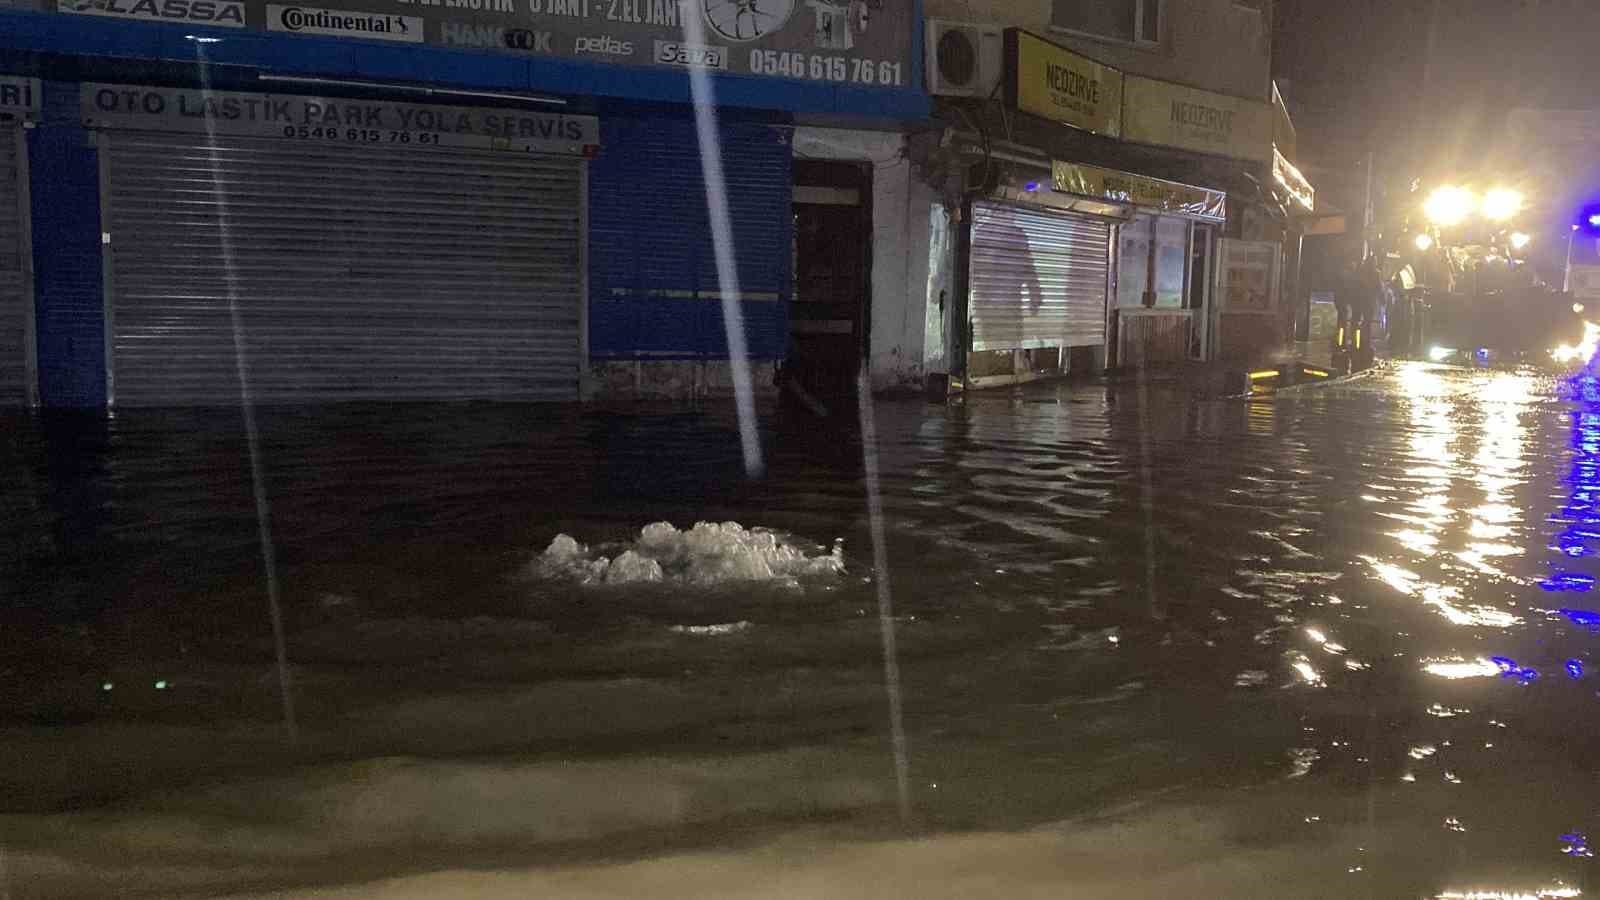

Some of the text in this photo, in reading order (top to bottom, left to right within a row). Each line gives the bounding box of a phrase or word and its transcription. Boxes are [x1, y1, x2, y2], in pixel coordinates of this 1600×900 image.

[281, 8, 391, 32] Continental
[750, 49, 901, 86] 0546 615 76 61
[96, 88, 584, 141] OTO LASTİK PARK YOLA SERVİS
[283, 126, 439, 145] 0546 615 76 61
